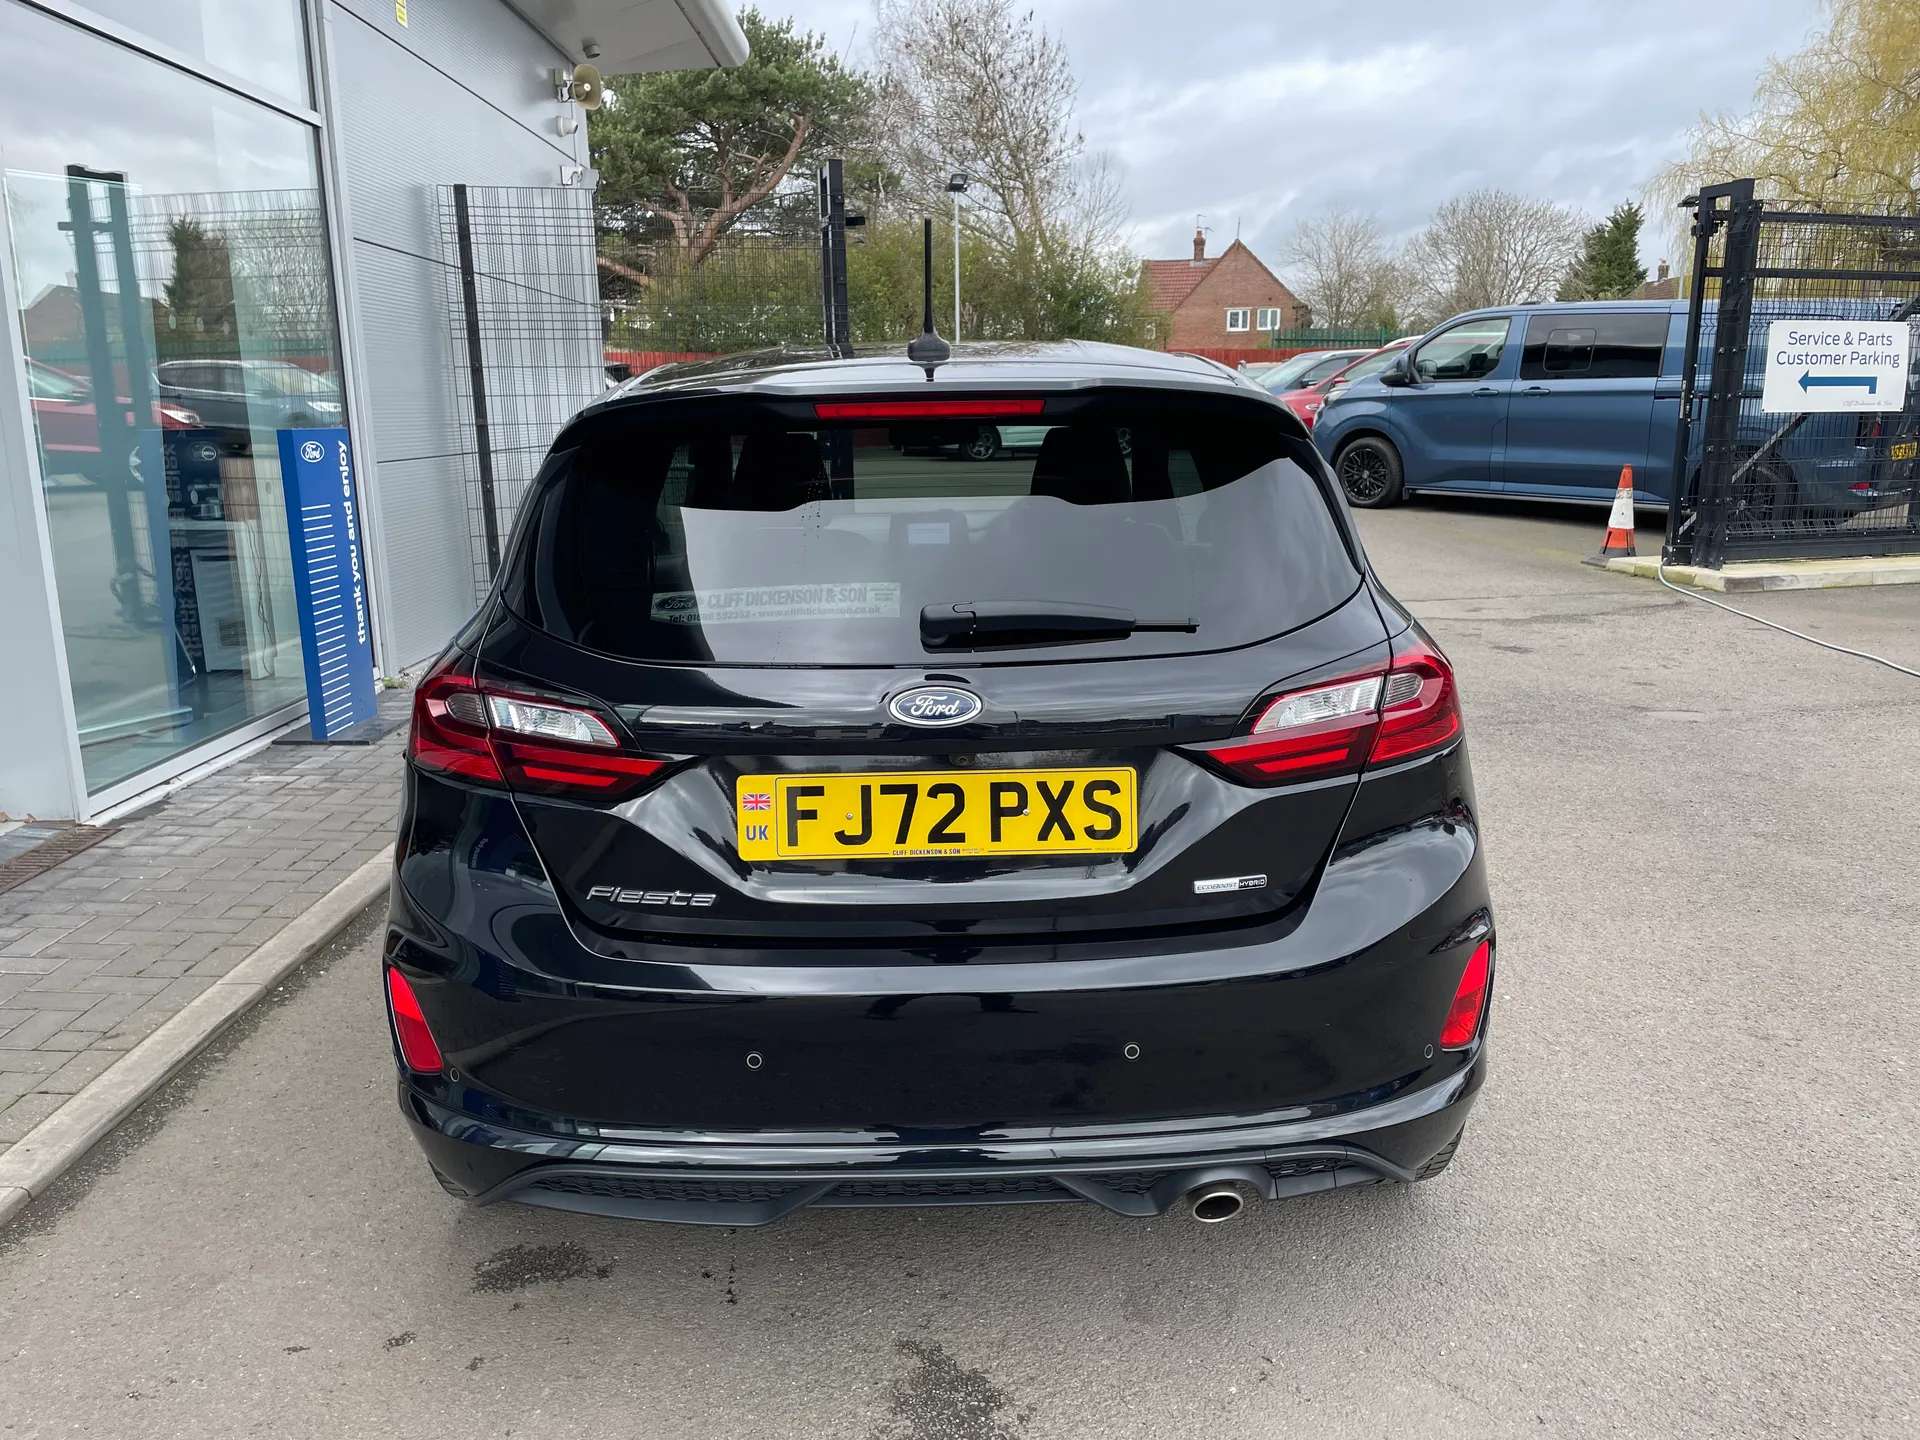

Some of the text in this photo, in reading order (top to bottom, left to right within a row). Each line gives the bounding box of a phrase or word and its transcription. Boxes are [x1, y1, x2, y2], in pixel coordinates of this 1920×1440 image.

[1788, 331, 1893, 346] Service & Parts
[1776, 351, 1900, 368] Customer Parking
[338, 440, 366, 644] thank you and enjoy
[707, 592, 744, 609] CLIFF
[745, 588, 822, 607] DICKENSON
[840, 586, 867, 603] SON
[910, 694, 960, 716] Ford
[786, 780, 1122, 847] FJ72 PXS
[745, 825, 769, 841] UK
[586, 886, 717, 907] Fiesta
